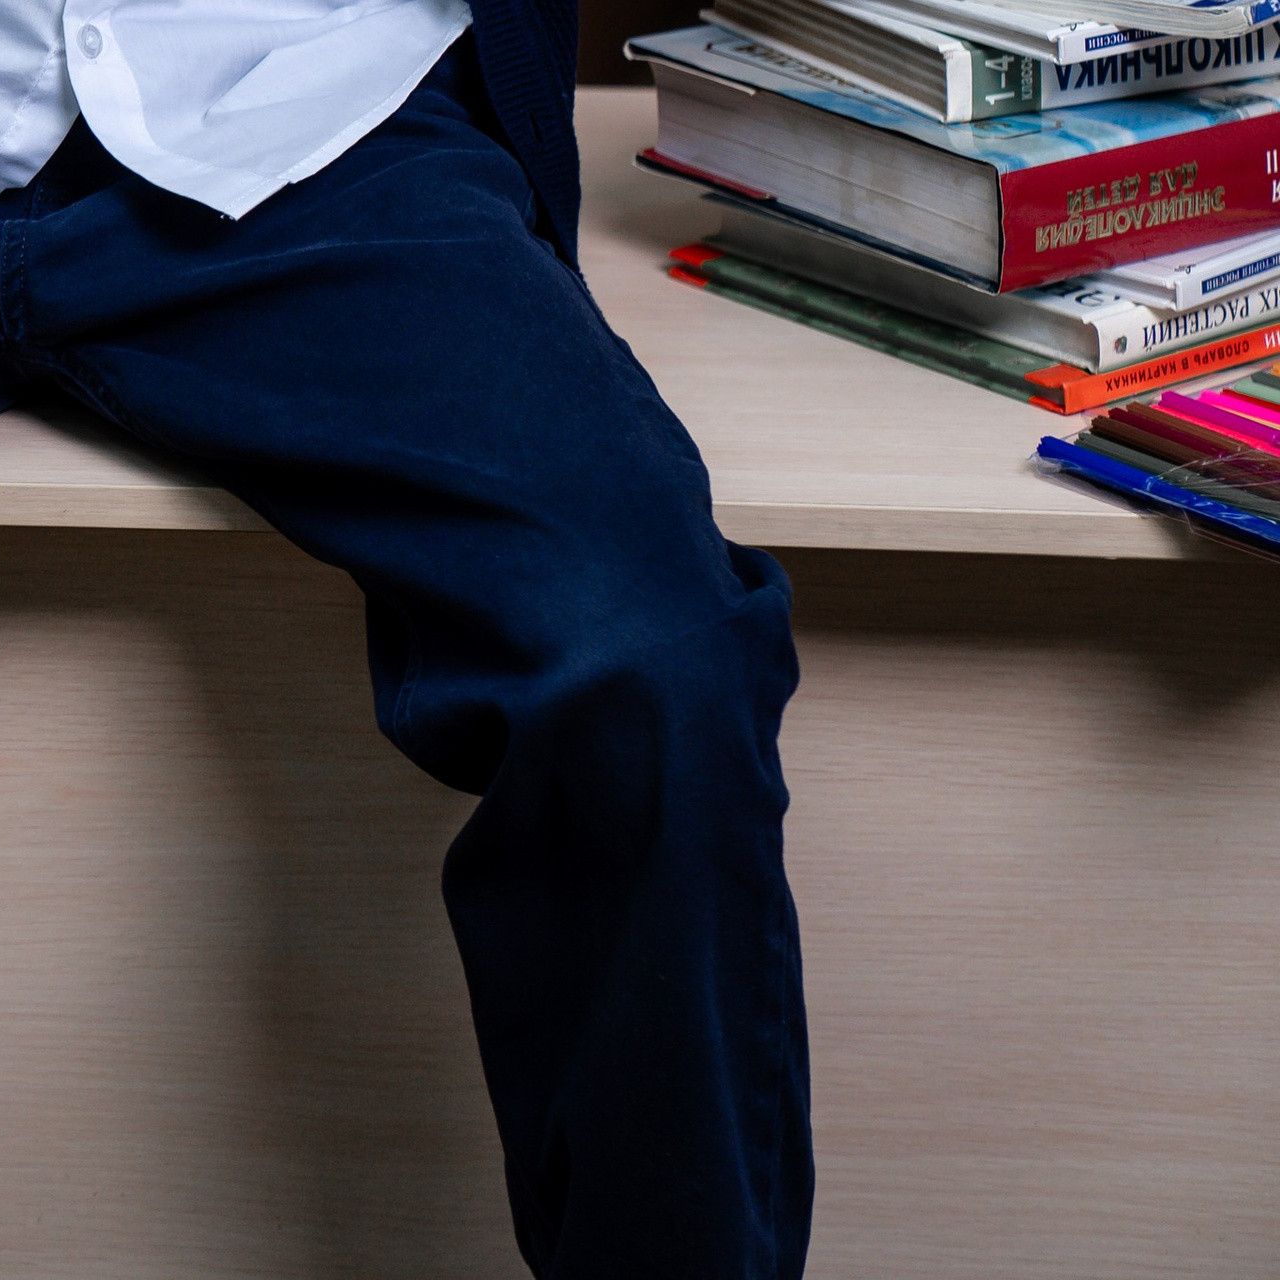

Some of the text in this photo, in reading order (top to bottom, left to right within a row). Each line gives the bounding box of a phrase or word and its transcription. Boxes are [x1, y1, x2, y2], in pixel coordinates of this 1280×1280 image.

[1052, 25, 1264, 91] ШКОЛЬНИКА
[1066, 159, 1199, 219] ДЛЯ ДЕТЕЙ
[1035, 186, 1226, 253] ЭНЦИКЛОПЕДИЯ
[1142, 294, 1250, 351] РАСТЕНИЙ
[1104, 340, 1250, 392] СЛОВАРЬ В КАРТИНКАХ
